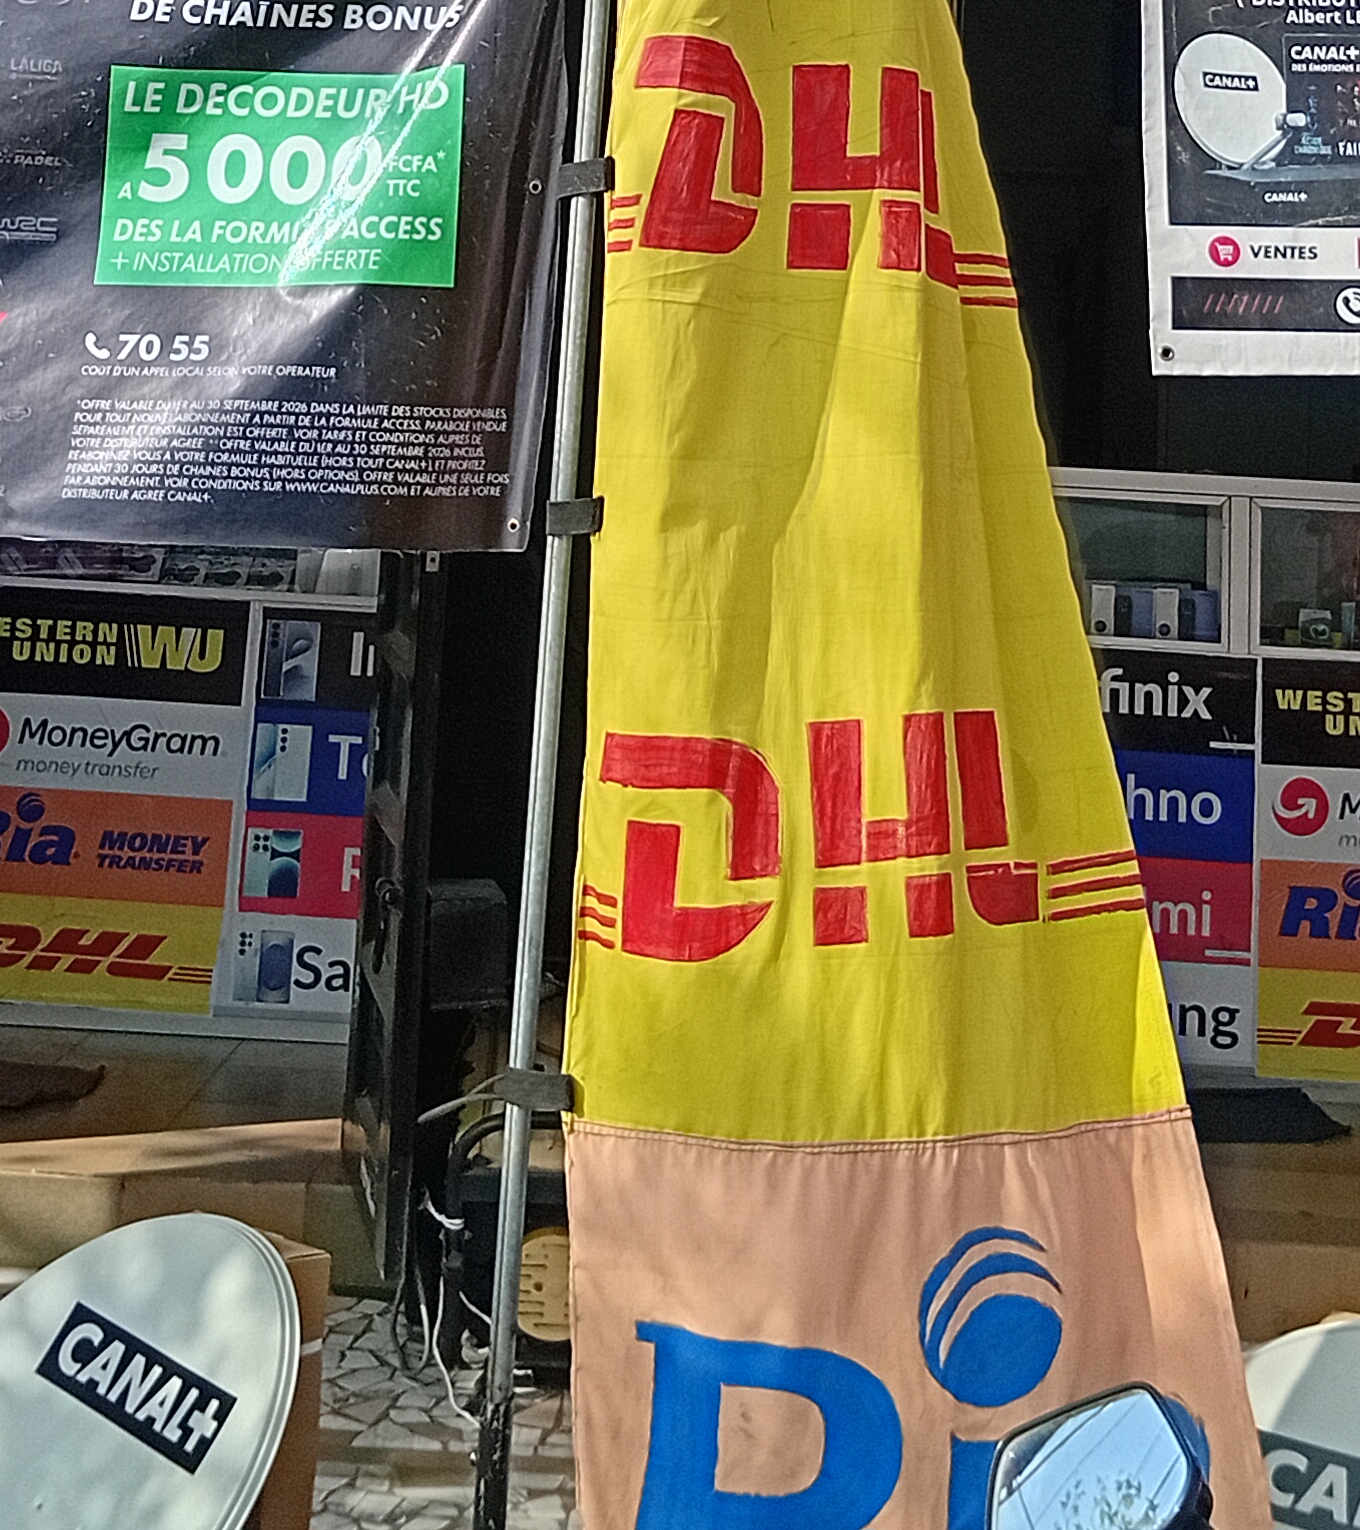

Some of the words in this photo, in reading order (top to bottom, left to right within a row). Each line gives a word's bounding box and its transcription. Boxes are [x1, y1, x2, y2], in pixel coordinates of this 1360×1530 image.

[342, 4, 464, 32] BONUS
[1285, 8, 1341, 26] Albert
[1290, 44, 1360, 62] CANAL+
[1204, 73, 1257, 90] CANAL+
[123, 80, 165, 114] LE
[398, 80, 450, 115] HD
[634, 33, 958, 290] DHL
[386, 178, 421, 197] TTC
[169, 219, 203, 243] LA
[342, 216, 443, 241] ACCESS
[133, 250, 284, 274] INSTALLATION
[1249, 245, 1319, 261] VENTES
[115, 333, 162, 361] 70
[168, 334, 210, 361] 55
[223, 399, 279, 411] SEPTEMBRE
[281, 400, 308, 412] 2026
[310, 402, 340, 414] DANS
[293, 429, 320, 440] VOIR
[11, 639, 117, 666] UNION
[138, 623, 225, 674] WU
[1099, 666, 1213, 721] finix
[16, 716, 221, 758] MoneyGram
[15, 757, 82, 778] money
[83, 760, 160, 780] transfer
[98, 829, 211, 858] MONEY
[599, 708, 1040, 963] DHL
[95, 852, 205, 876] TRANSFER
[56, 1320, 221, 1456] CANAL+
